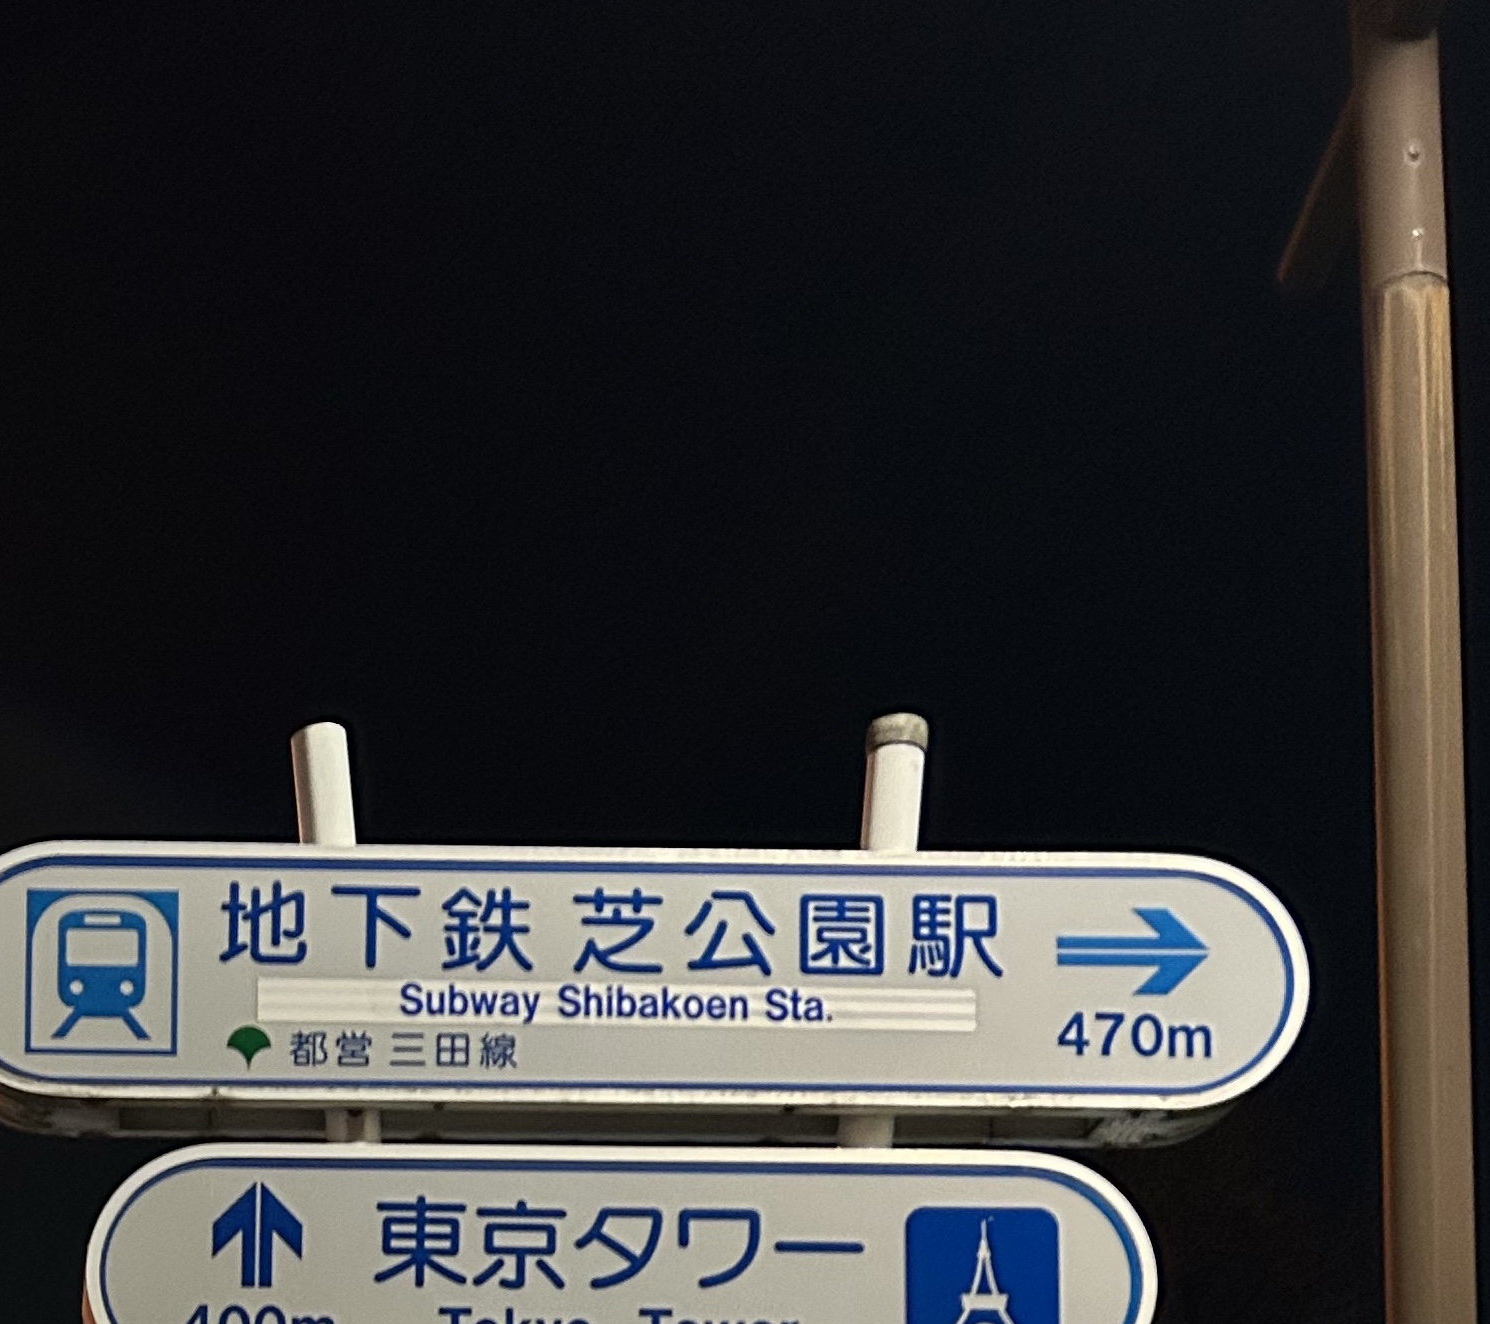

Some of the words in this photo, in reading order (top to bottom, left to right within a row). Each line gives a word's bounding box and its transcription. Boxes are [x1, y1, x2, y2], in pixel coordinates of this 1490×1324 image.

[400, 983, 540, 1023] Subway
[557, 984, 749, 1020] Shibakoen
[765, 988, 833, 1022] Sta.
[1057, 1012, 1212, 1058] 470m
[373, 1195, 864, 1290] 東京タワー
